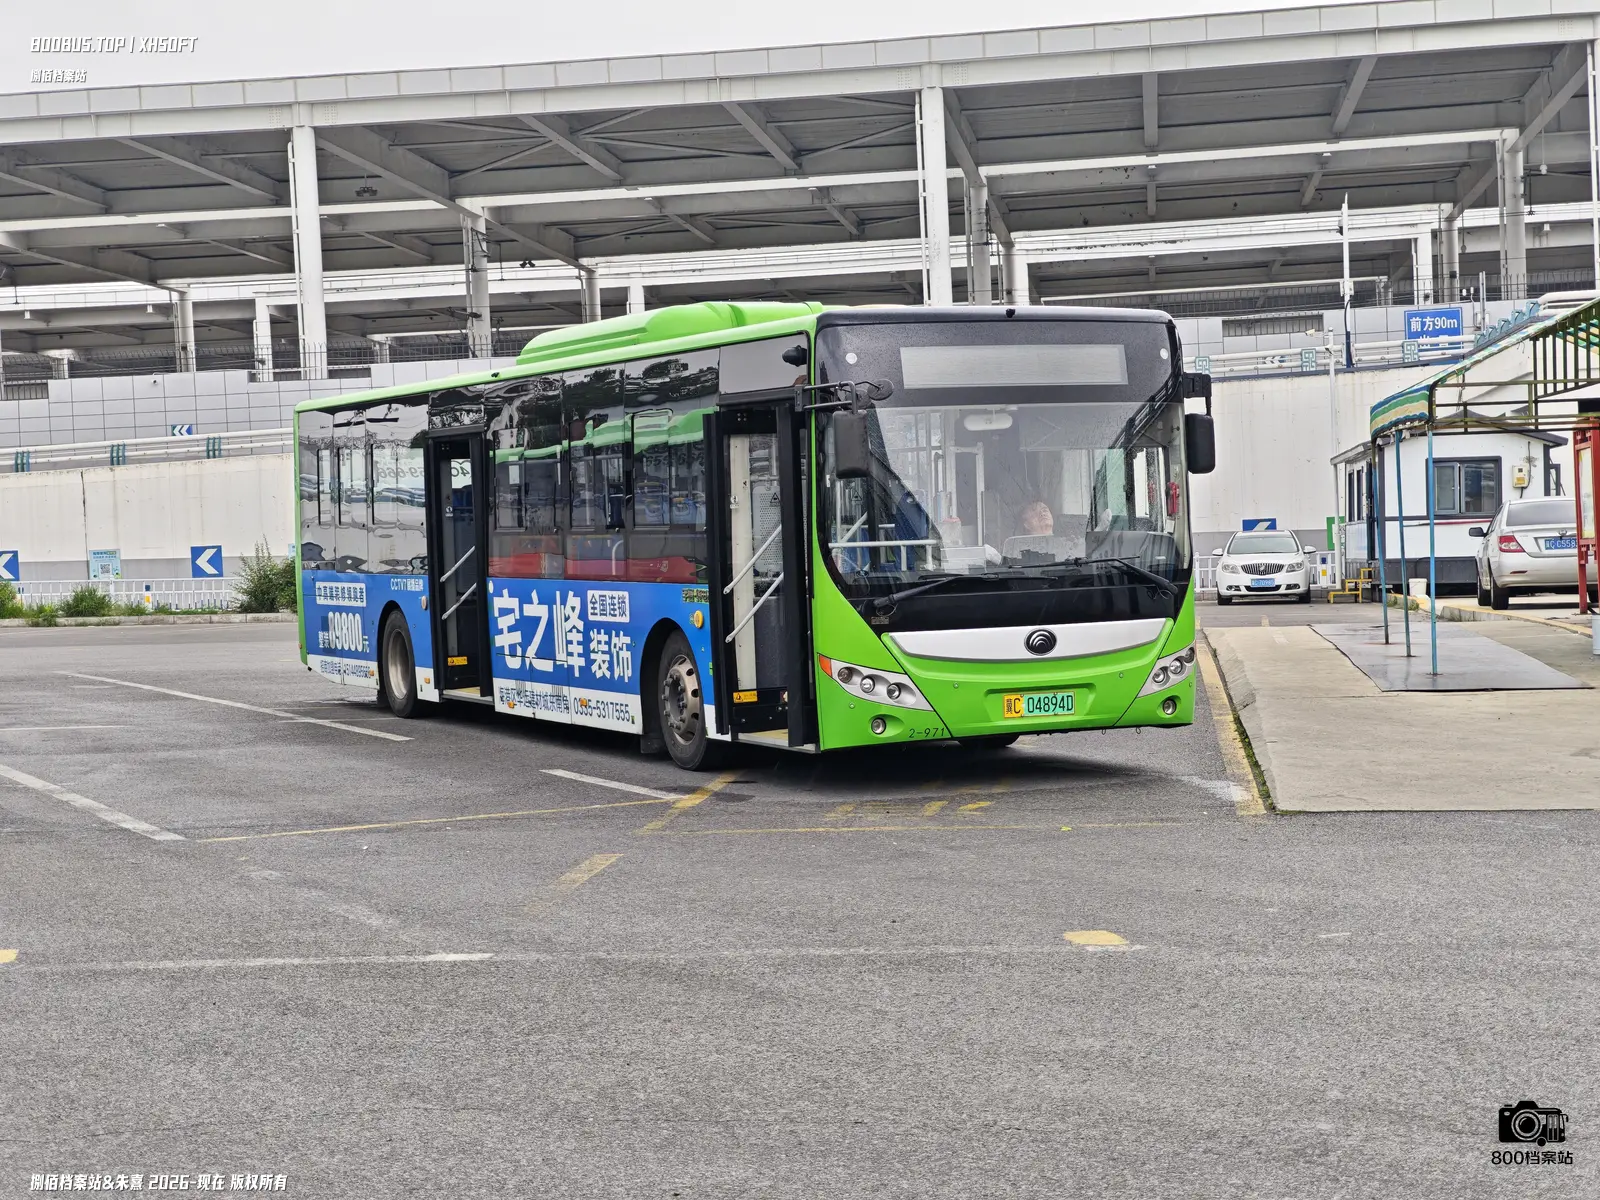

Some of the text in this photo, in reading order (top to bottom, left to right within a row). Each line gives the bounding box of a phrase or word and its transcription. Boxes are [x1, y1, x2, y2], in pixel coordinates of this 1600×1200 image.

[1409, 316, 1458, 332] 前方90m
[589, 593, 627, 619] 全国连锁
[493, 588, 586, 678] 宅之峰
[589, 628, 633, 683] 装饰
[908, 727, 945, 739] 2-971
